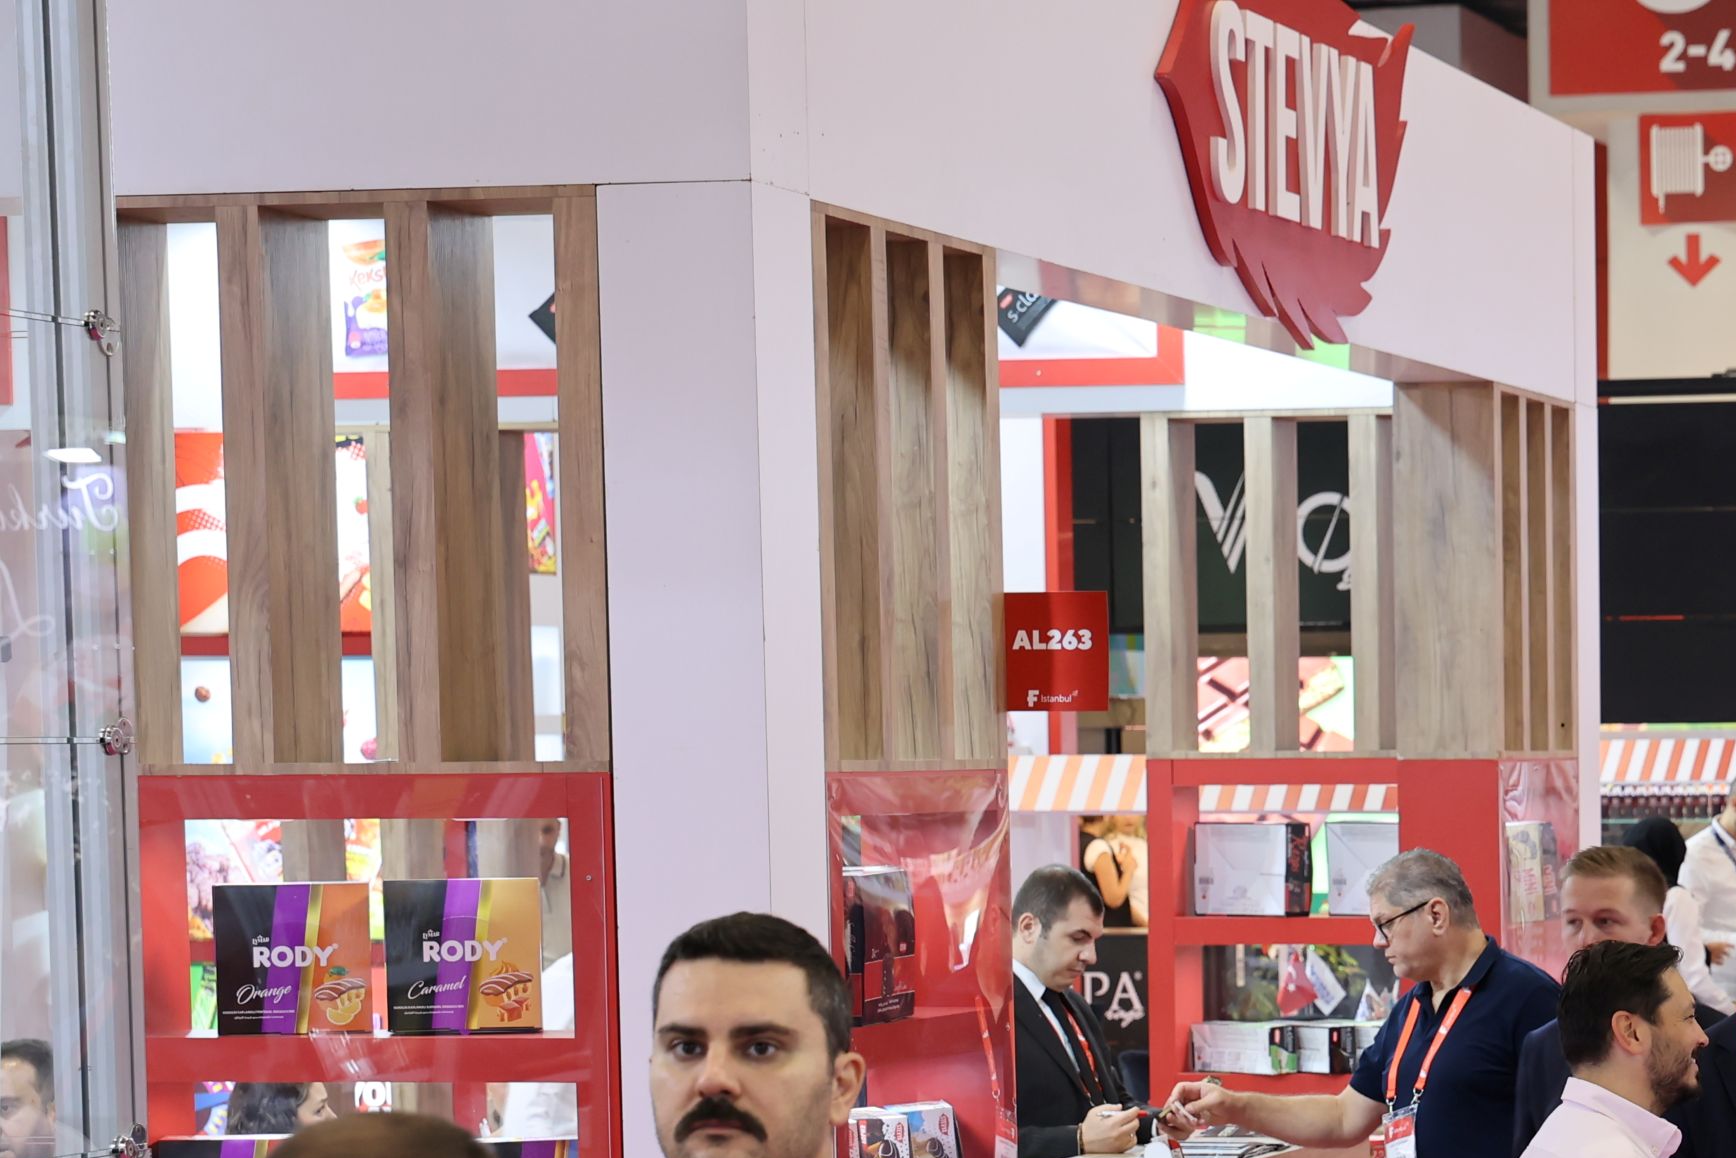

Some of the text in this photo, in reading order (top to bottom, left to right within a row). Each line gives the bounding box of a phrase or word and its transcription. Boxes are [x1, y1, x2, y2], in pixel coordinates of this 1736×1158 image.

[1210, 0, 1380, 249] STEVYA
[1011, 628, 1093, 651] AL263
[1041, 694, 1073, 703] Istanbul
[252, 945, 334, 968] RODY
[423, 939, 503, 963] RODY
[236, 983, 292, 1005] Orange
[407, 975, 467, 1000] Caramel
